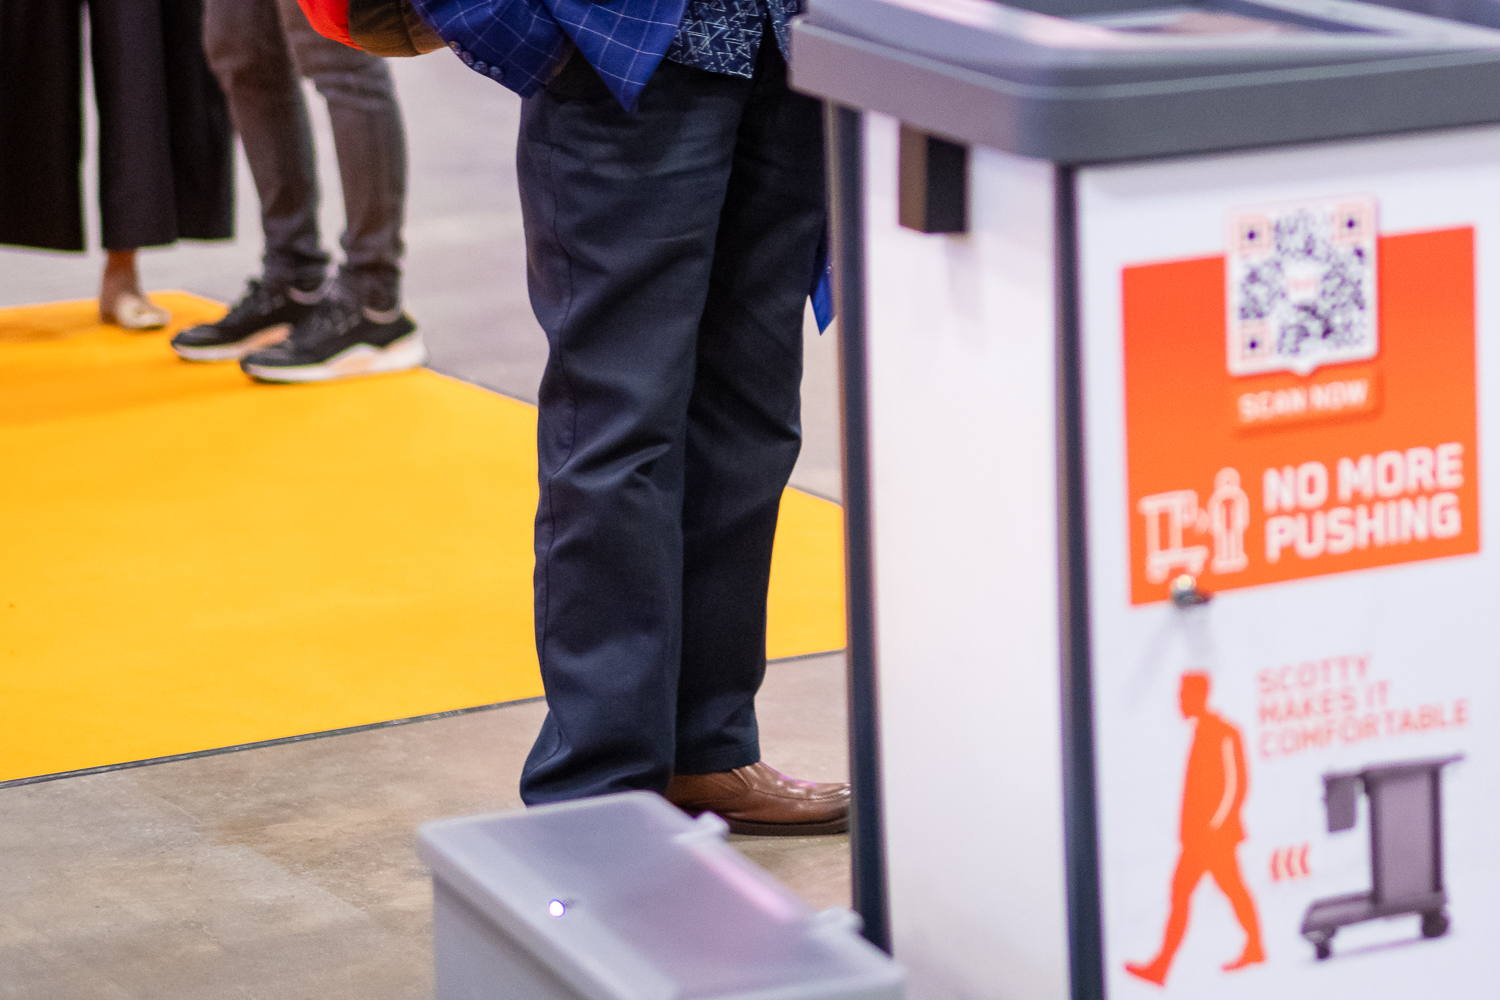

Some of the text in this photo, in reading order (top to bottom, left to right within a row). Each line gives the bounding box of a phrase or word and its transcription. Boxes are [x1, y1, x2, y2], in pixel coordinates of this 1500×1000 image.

[1238, 379, 1369, 422] SCAN NOW
[1263, 442, 1464, 513] NO MORE
[1264, 492, 1462, 564] PUSHING
[1257, 653, 1371, 695] SCOTTY
[1258, 679, 1390, 725] MAKES IT
[1259, 697, 1470, 762] COMFORTABLE
